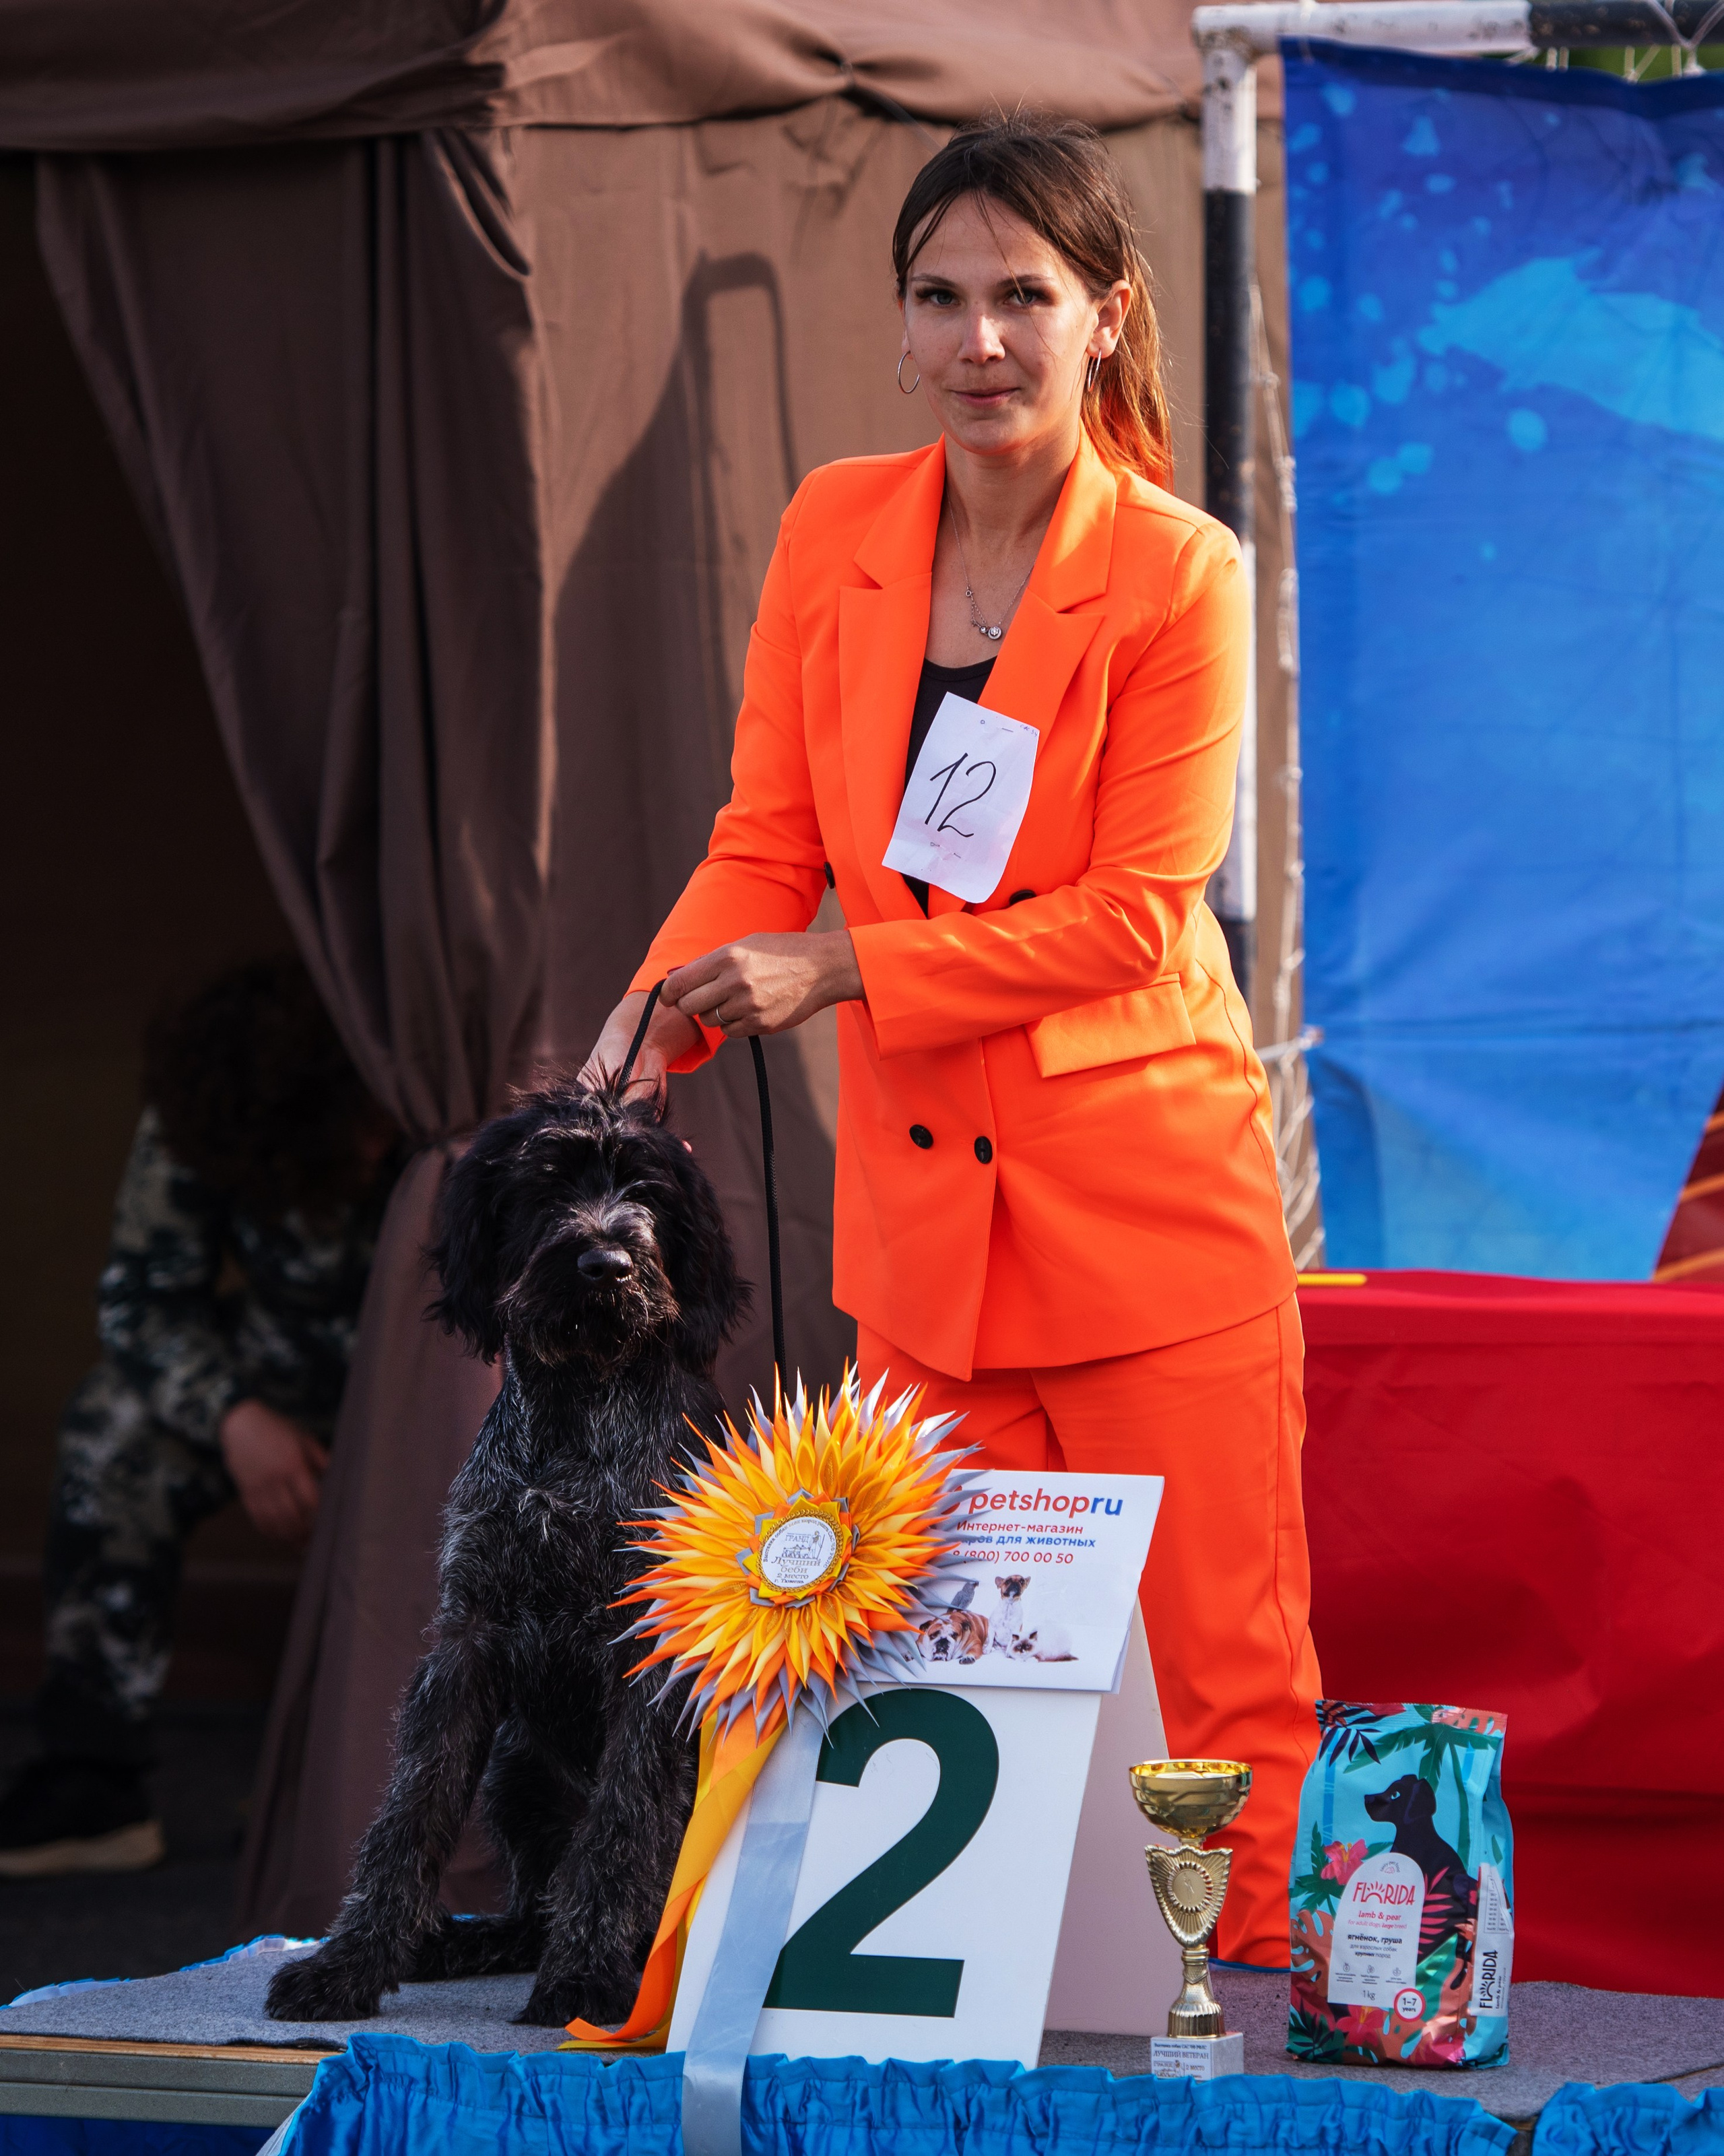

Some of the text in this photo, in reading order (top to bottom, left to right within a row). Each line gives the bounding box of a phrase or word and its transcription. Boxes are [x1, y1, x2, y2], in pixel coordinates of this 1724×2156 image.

[925, 752, 996, 837] 12
[968, 1489, 1123, 1519] petshopru
[956, 1520, 1083, 1534] Интернет-магазин
[996, 1536, 1022, 1546] для
[1026, 1536, 1096, 1548] животных
[771, 1557, 821, 1567] Лучший
[1004, 1551, 1030, 1563] 700
[1033, 1553, 1052, 1563] 00
[1055, 1553, 1073, 1564] 50
[781, 1565, 807, 1573] беби
[762, 1688, 999, 2018] 2
[1352, 1881, 1416, 1905] FLORIDA
[1348, 1933, 1379, 1942] ягнёнок,
[1480, 1950, 1498, 2008] FLORIDA
[1368, 1990, 1375, 2000] kg
